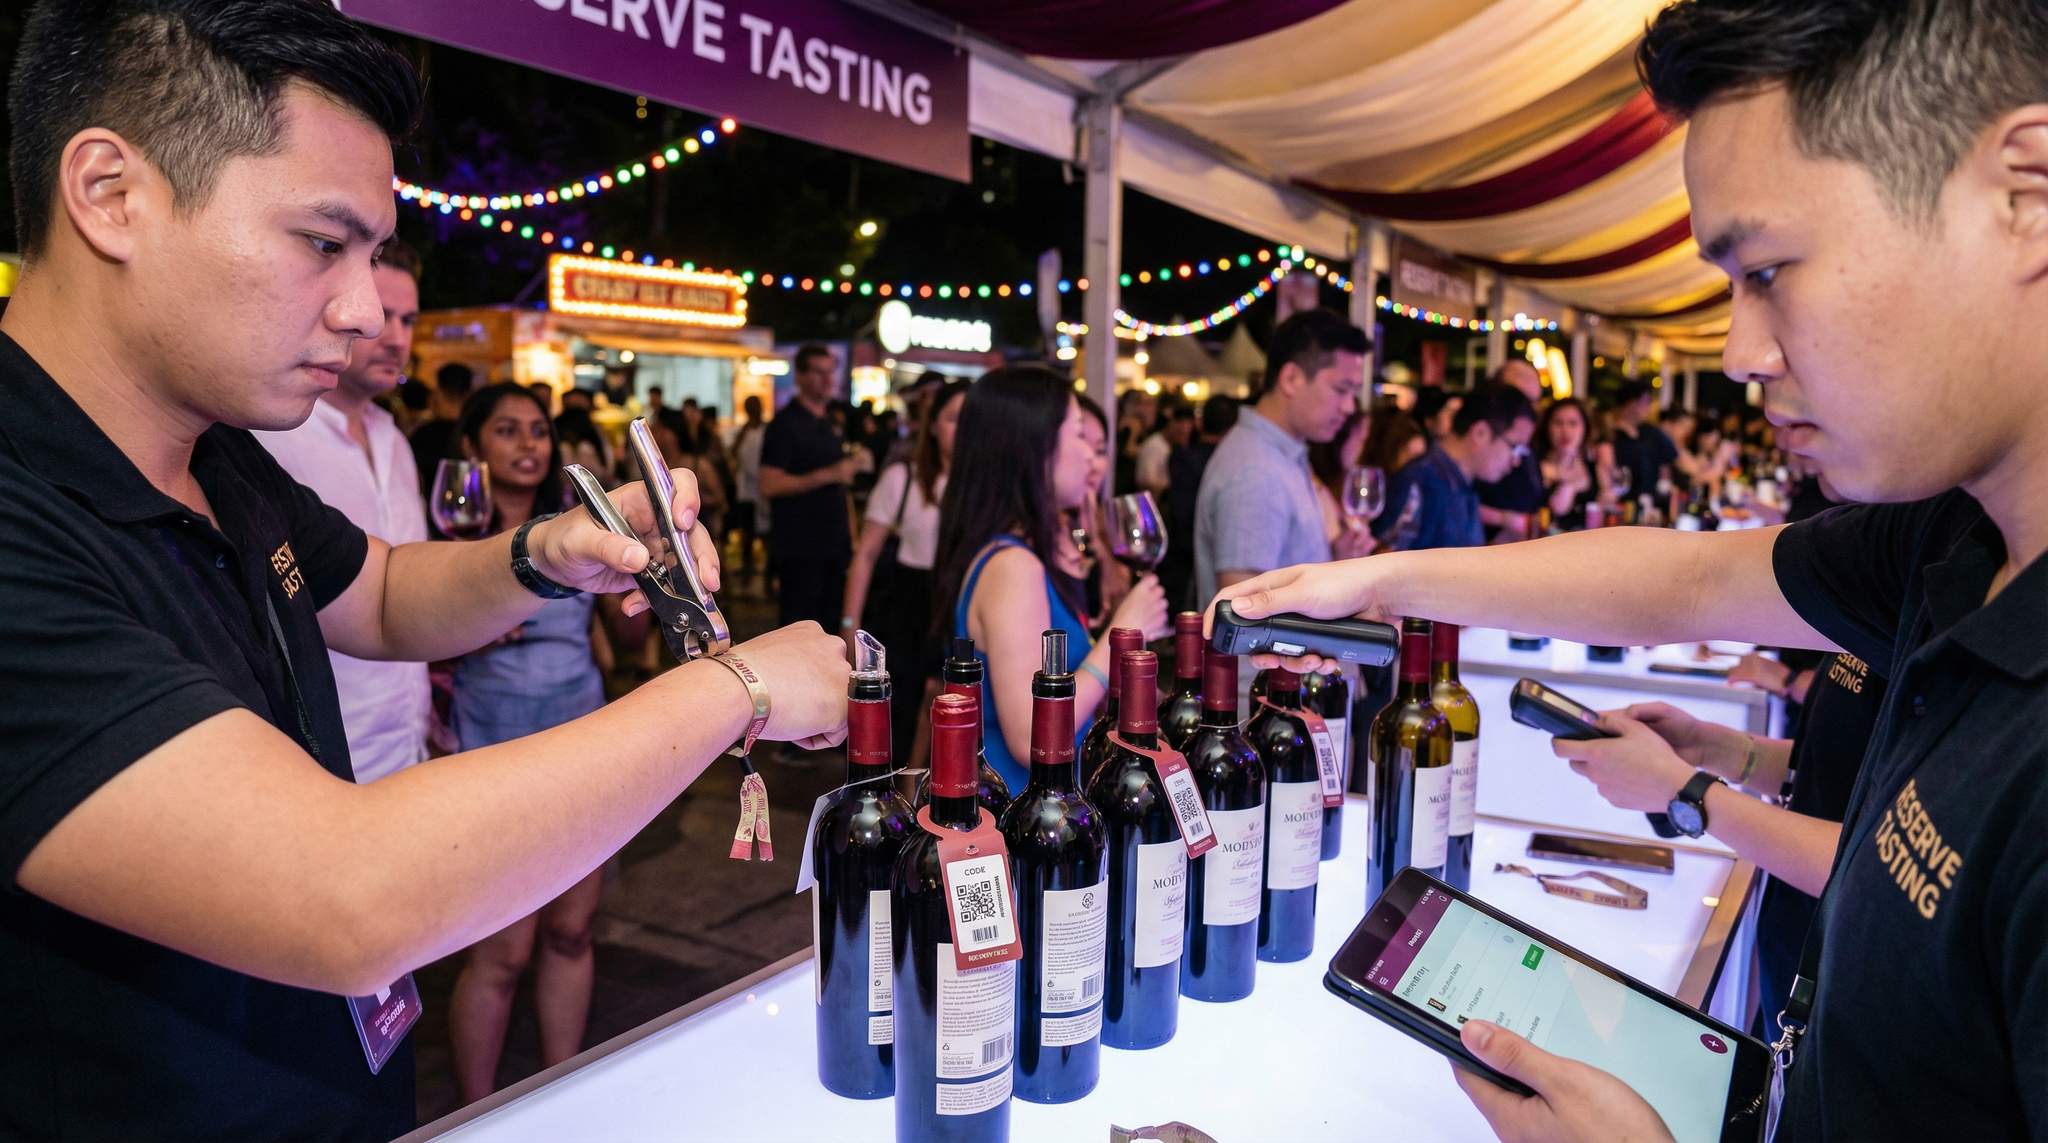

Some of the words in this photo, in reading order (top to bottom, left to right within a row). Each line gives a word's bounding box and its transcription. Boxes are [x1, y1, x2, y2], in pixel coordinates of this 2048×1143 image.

[739, 12, 933, 125] TASTING
[964, 865, 987, 877] CODE
[1875, 809, 1940, 920] TASTING
